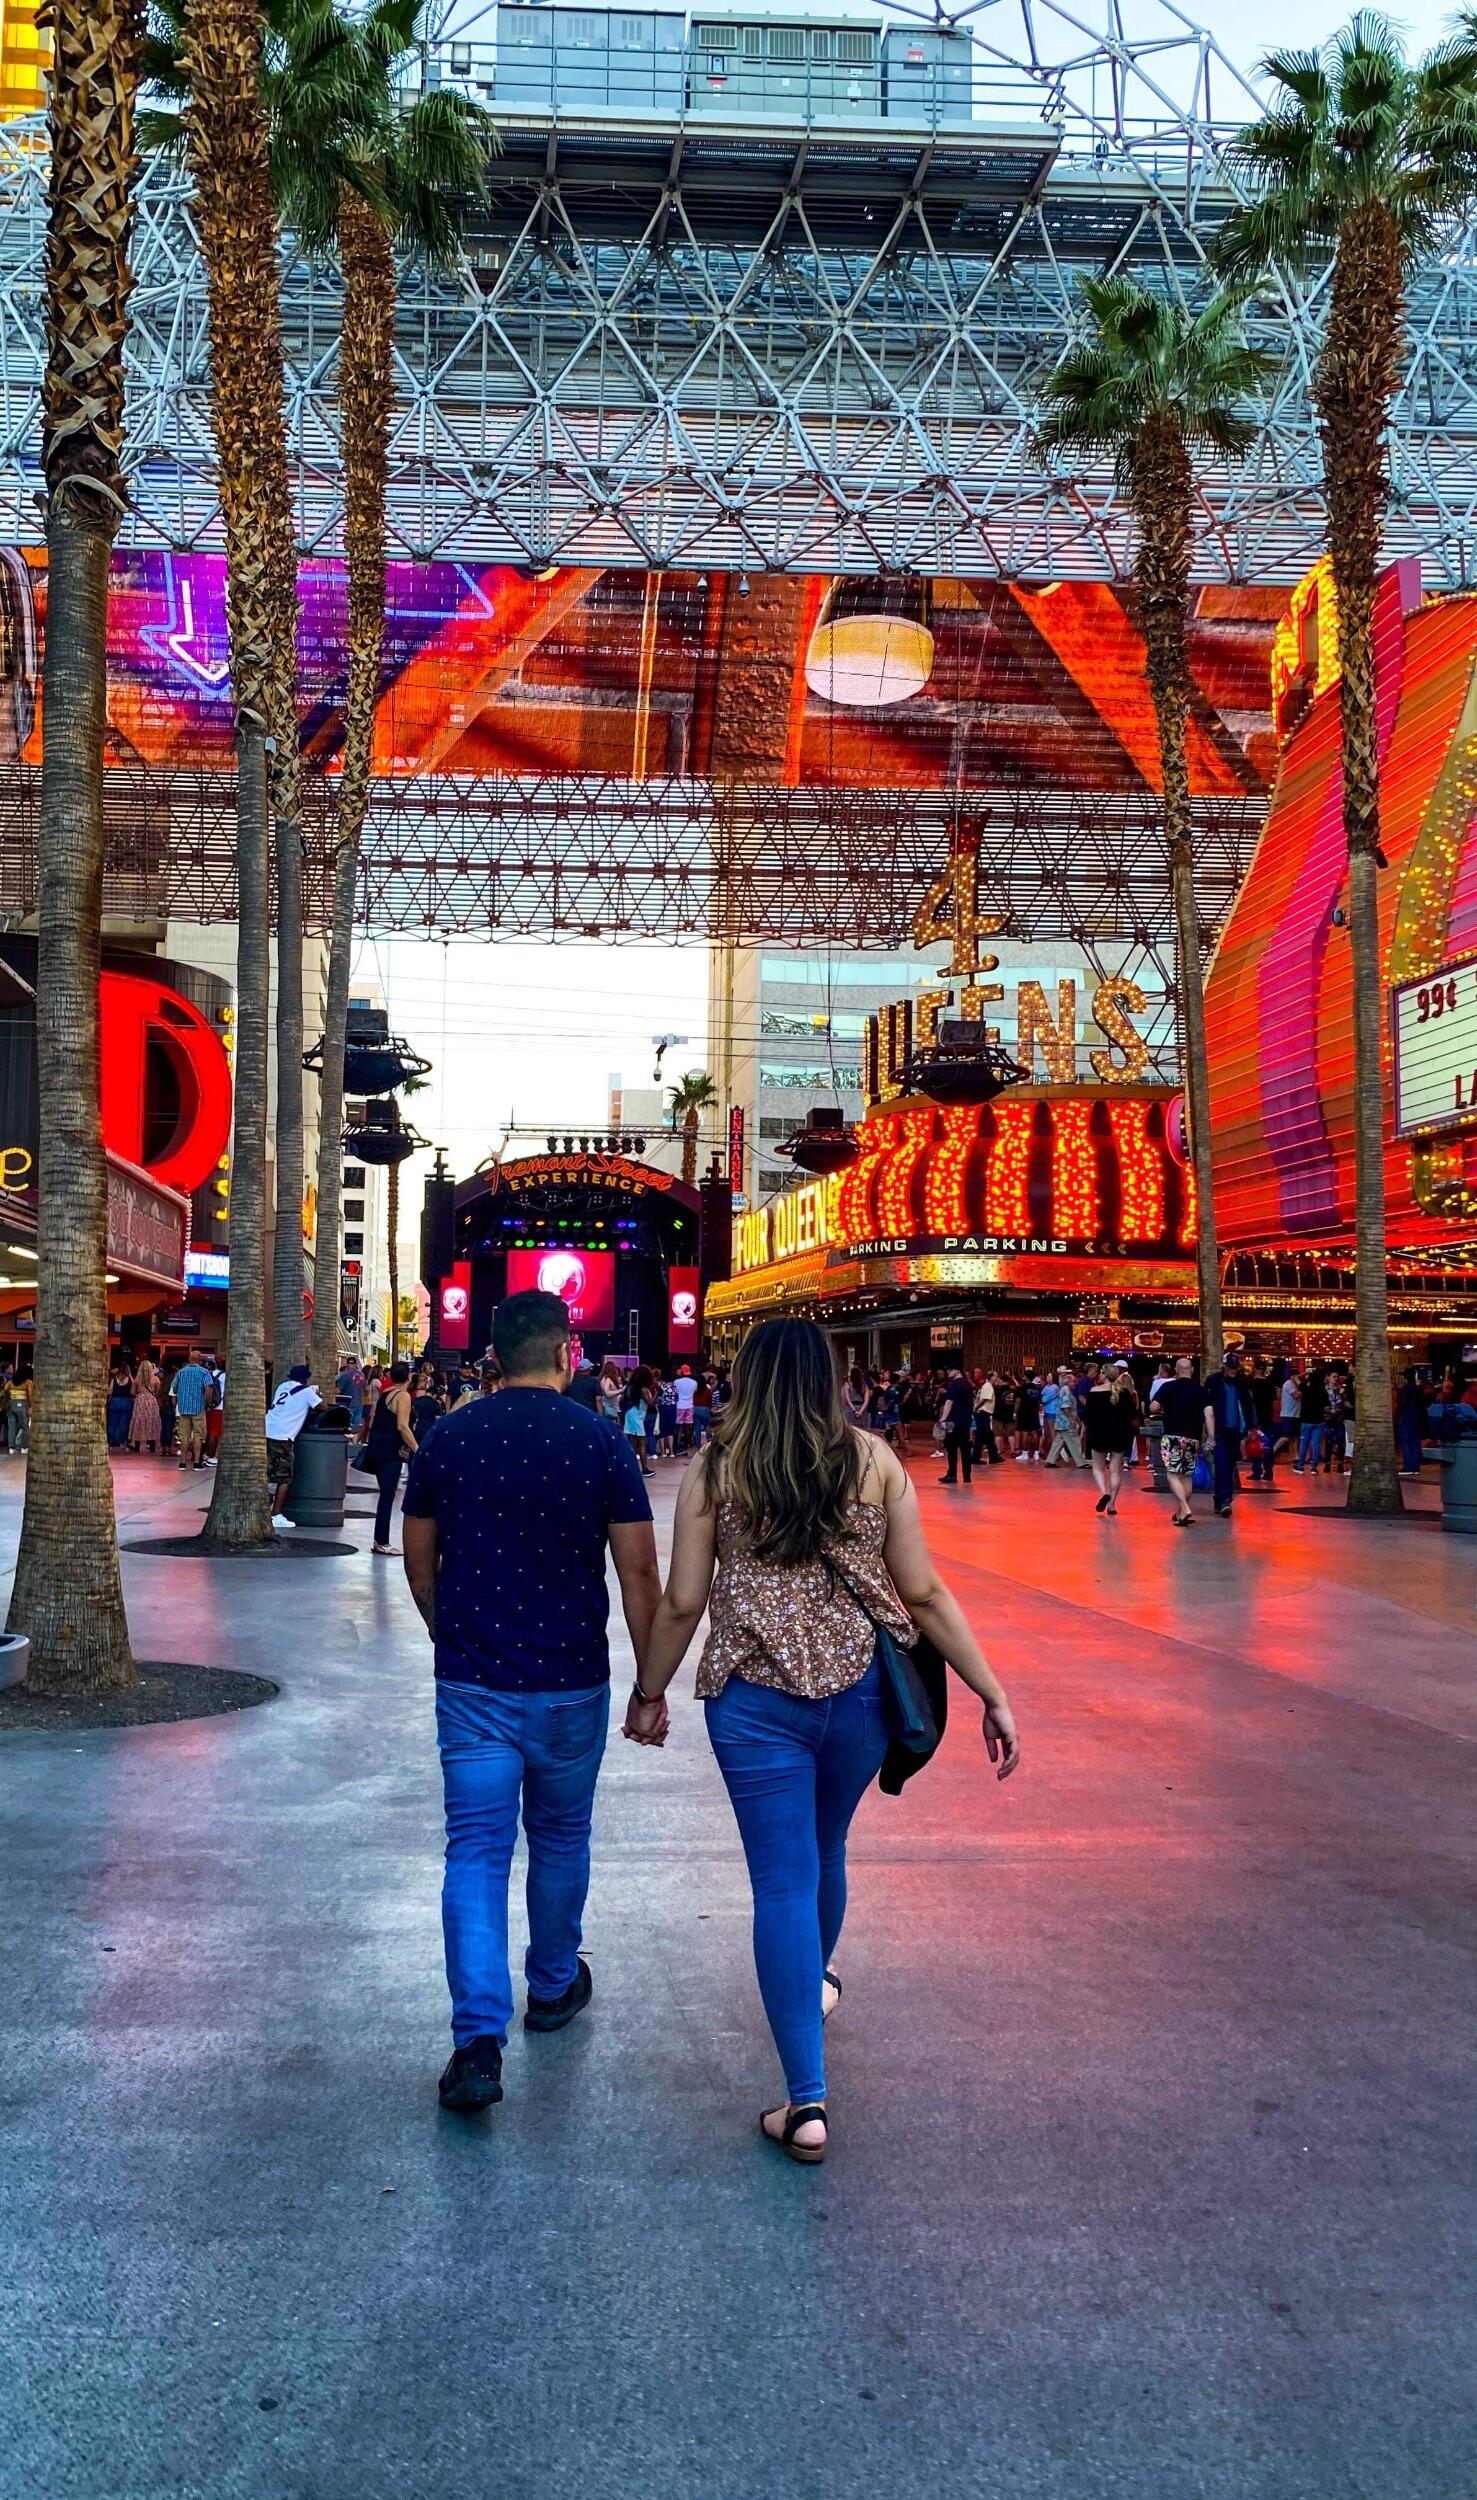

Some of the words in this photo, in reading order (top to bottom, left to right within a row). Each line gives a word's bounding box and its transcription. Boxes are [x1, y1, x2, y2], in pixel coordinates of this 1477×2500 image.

[912, 849, 1014, 977] 4
[1417, 977, 1457, 1022] 99¢
[484, 1148, 588, 1195] Fremont
[587, 1145, 676, 1190] Street
[731, 1110, 743, 1190] ENTRANCE
[510, 1172, 647, 1194] EXPERIENCE
[736, 1207, 768, 1271] FOUR
[849, 1239, 907, 1256] PARKING
[945, 1237, 1067, 1252] PARKING
[346, 1318, 354, 1329] P
